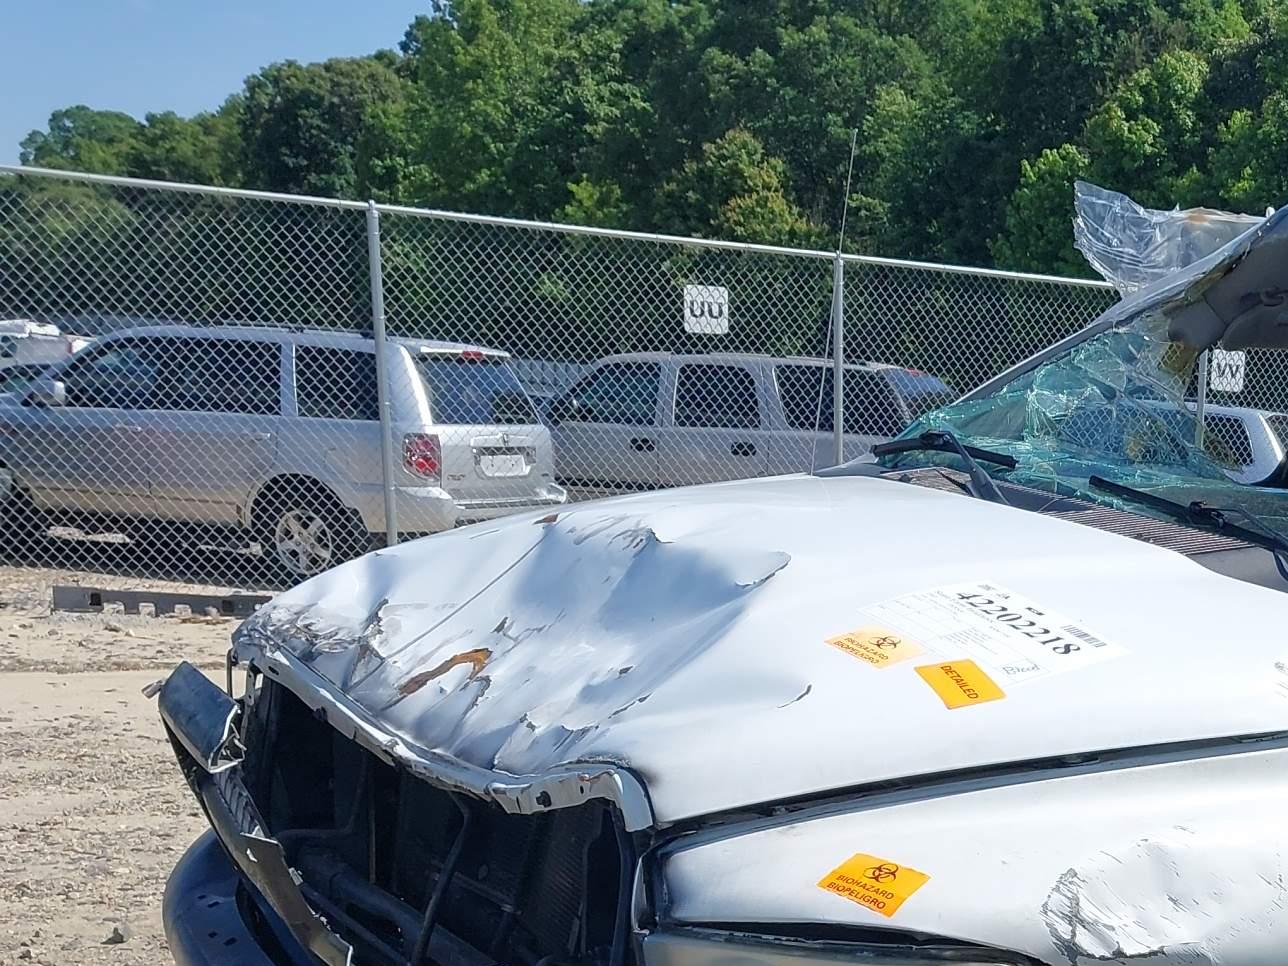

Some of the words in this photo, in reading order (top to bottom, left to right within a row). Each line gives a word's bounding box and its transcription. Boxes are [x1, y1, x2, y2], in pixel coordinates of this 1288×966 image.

[956, 592, 1081, 655] 42202218
[940, 665, 979, 699] DETAILED
[826, 881, 887, 910] BIOPELIGRO
[835, 874, 895, 900] BIOHAZARD
